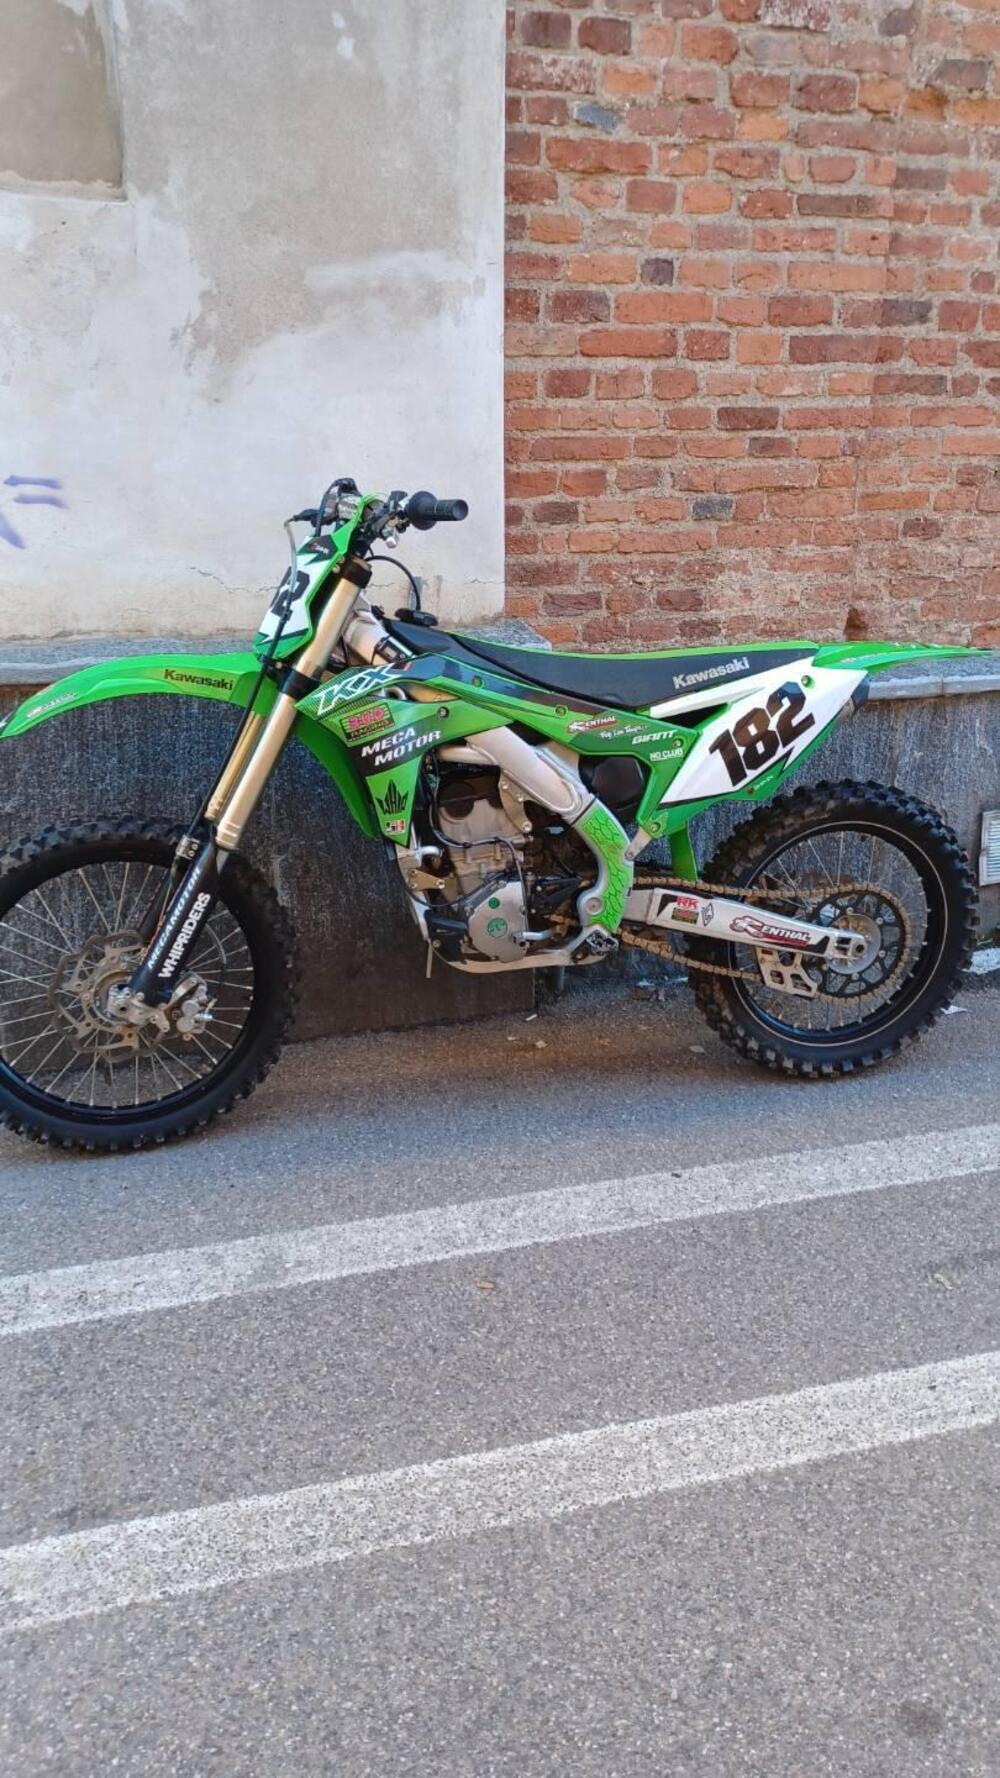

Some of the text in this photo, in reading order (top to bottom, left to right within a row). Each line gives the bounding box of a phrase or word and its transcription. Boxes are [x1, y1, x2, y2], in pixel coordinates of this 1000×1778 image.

[164, 668, 235, 691] Kawasaki
[672, 656, 750, 690] Kawasaki
[361, 727, 416, 758] MECA
[374, 730, 441, 767] MOTOR
[708, 681, 816, 787] 182
[158, 892, 211, 978] WHIPRIDERS
